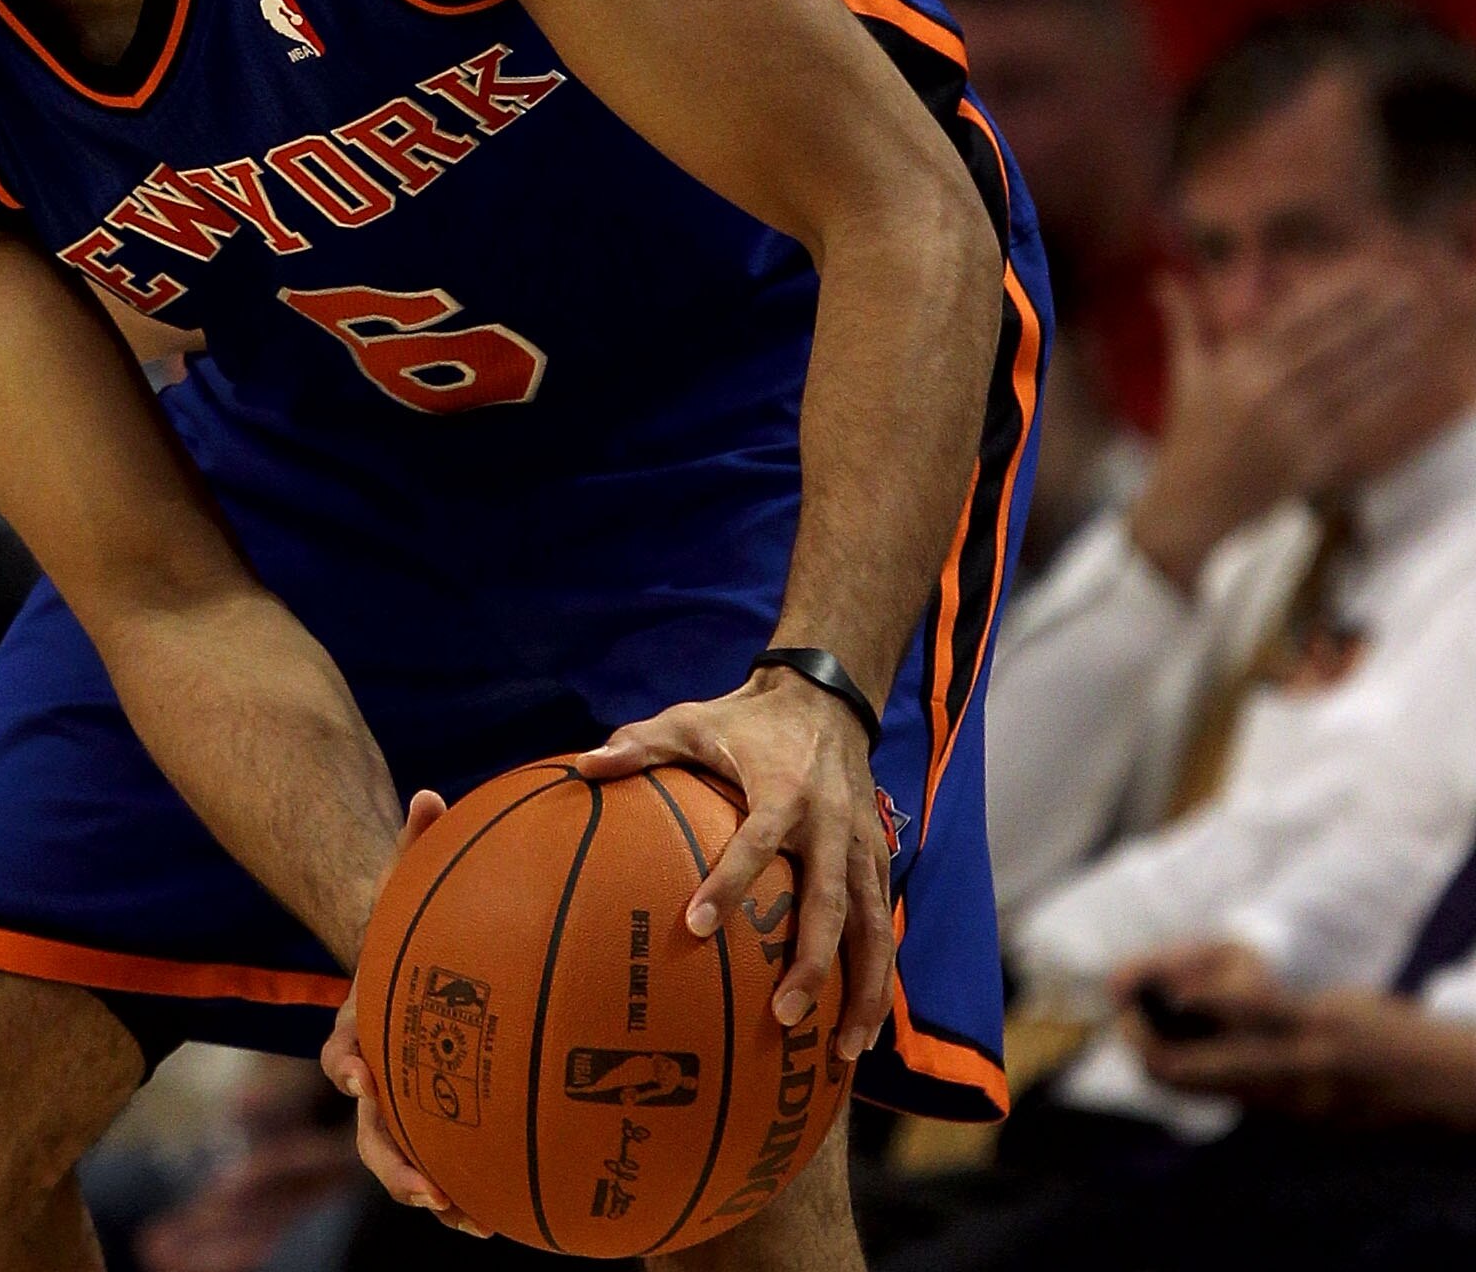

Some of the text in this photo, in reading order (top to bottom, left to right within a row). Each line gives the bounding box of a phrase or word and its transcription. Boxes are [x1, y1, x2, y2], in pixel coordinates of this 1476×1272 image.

[287, 45, 315, 63] NBA
[56, 42, 567, 315] EW YORK
[276, 285, 548, 415] 6
[628, 910, 650, 1032] OFFICIAL GAME BALL
[574, 1053, 592, 1086] NBA
[708, 890, 821, 1221] SLDING
